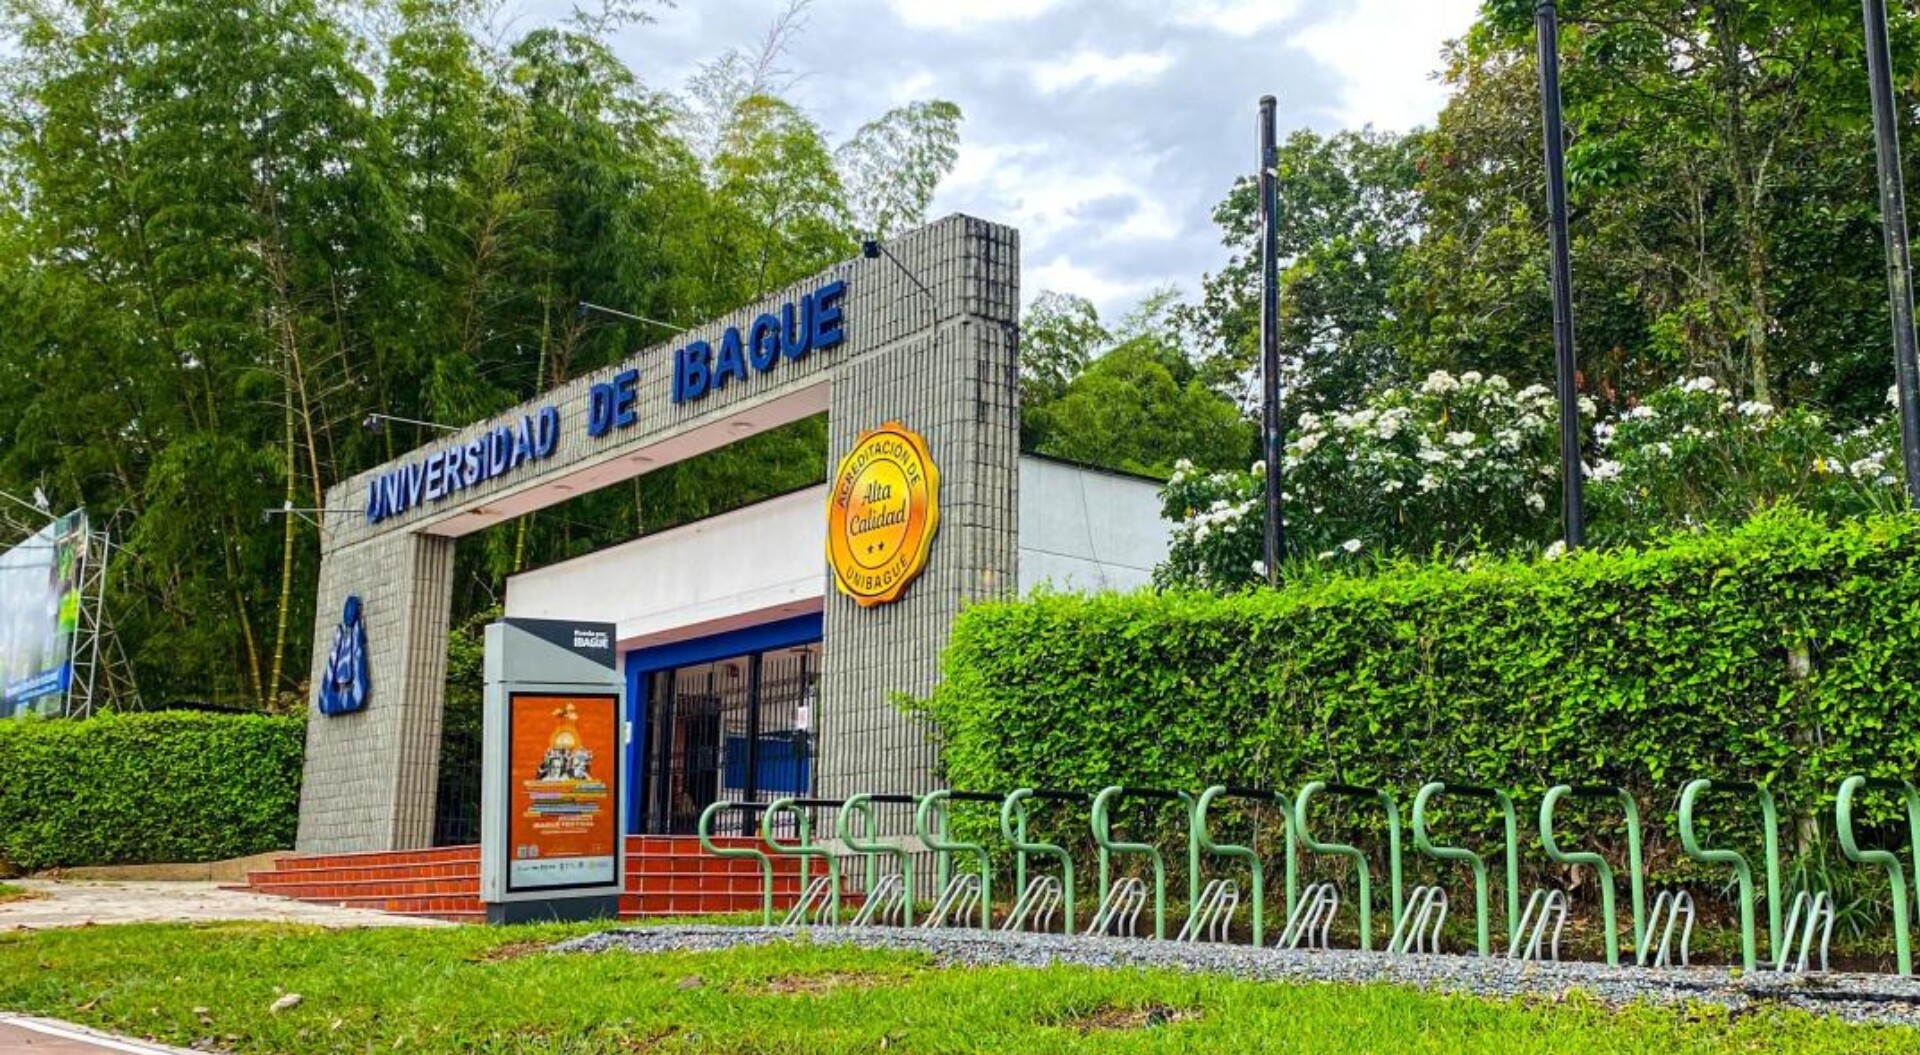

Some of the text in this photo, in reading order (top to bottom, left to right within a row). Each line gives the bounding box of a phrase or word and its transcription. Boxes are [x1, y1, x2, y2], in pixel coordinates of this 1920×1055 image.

[365, 280, 846, 524] UNIVERSIDAD DE IBAGUE
[839, 438, 922, 509] ACREDITACIÓN DE
[862, 480, 892, 506] Alta
[849, 499, 906, 537] Calidad
